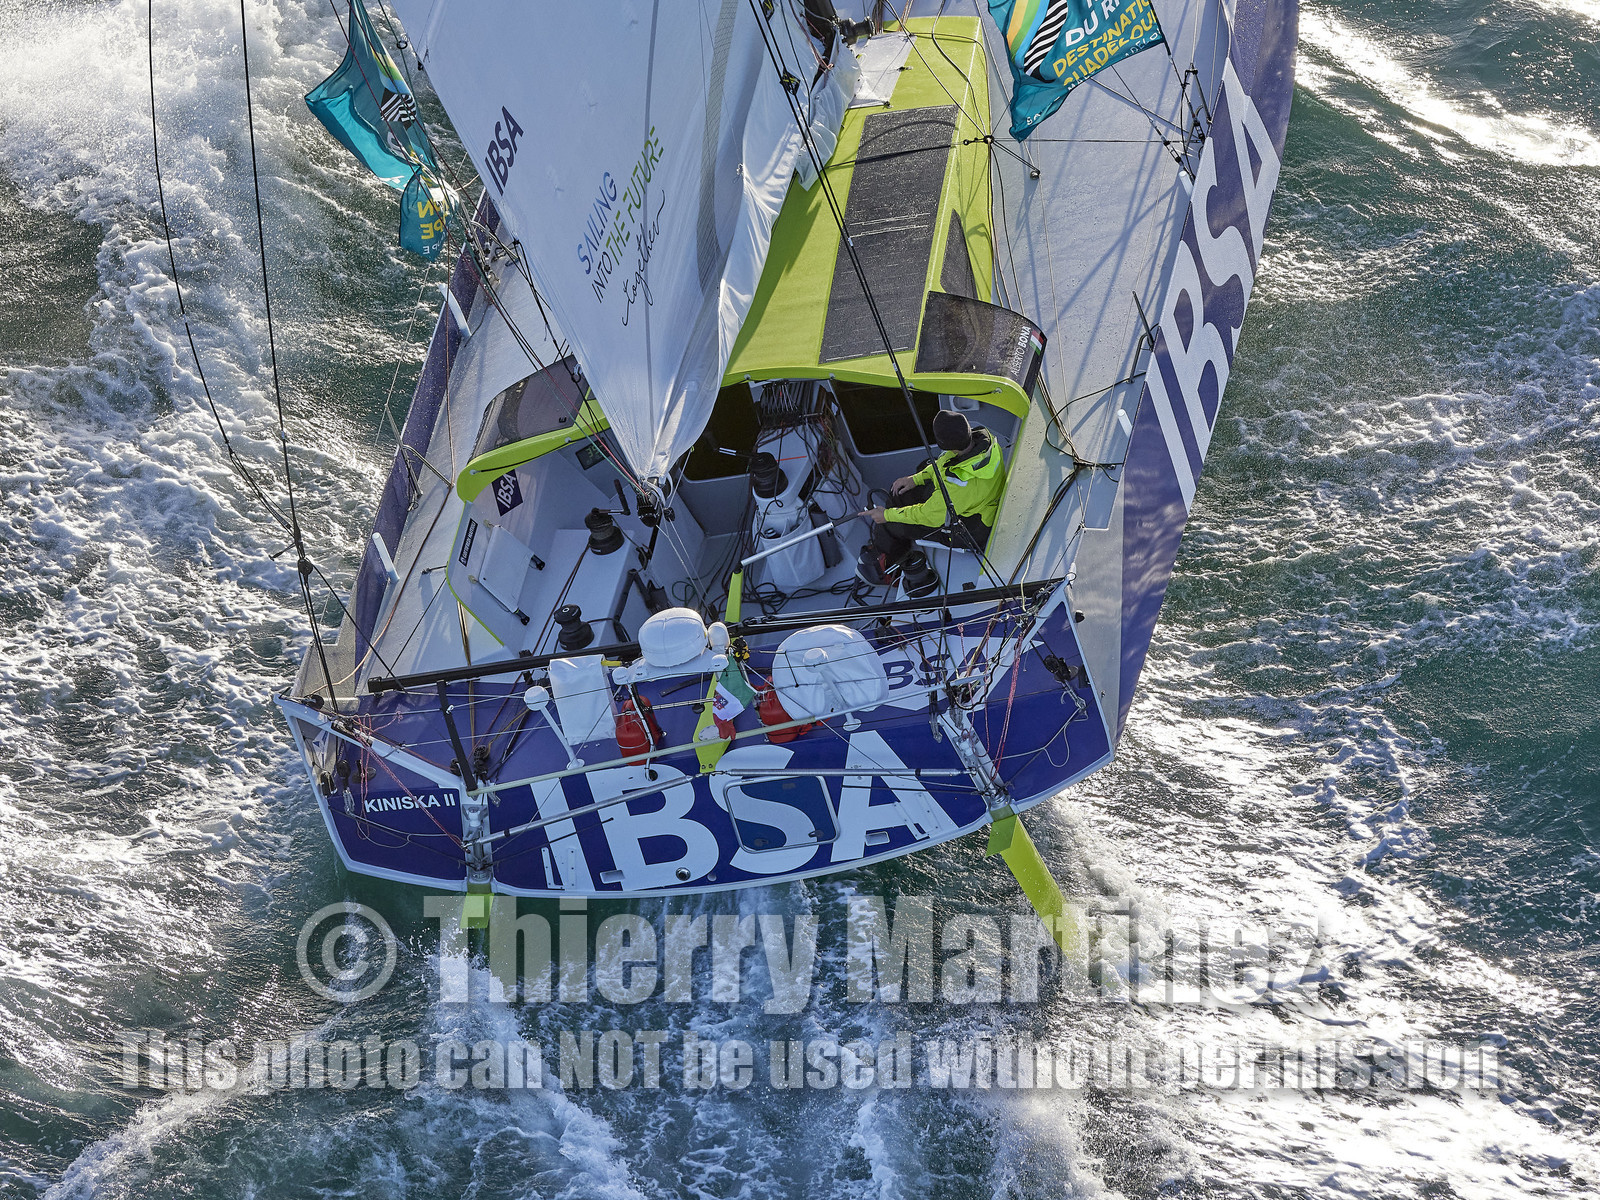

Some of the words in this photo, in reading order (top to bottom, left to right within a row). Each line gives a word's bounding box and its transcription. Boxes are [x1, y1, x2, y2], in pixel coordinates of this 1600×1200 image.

[1065, 12, 1099, 47] DU
[485, 105, 524, 197] IBSA
[577, 171, 617, 275] SAILING
[592, 251, 613, 304] INTO
[605, 210, 630, 266] THE
[622, 125, 665, 224] FUTURE
[621, 189, 666, 327] together
[1145, 57, 1281, 516] IBSA
[1010, 347, 1026, 377] ALBERTO
[1017, 325, 1032, 349] BONA
[497, 473, 517, 509] IBSA
[364, 794, 441, 813] KINISKA
[443, 793, 456, 807] II
[530, 730, 958, 891] IBSA
